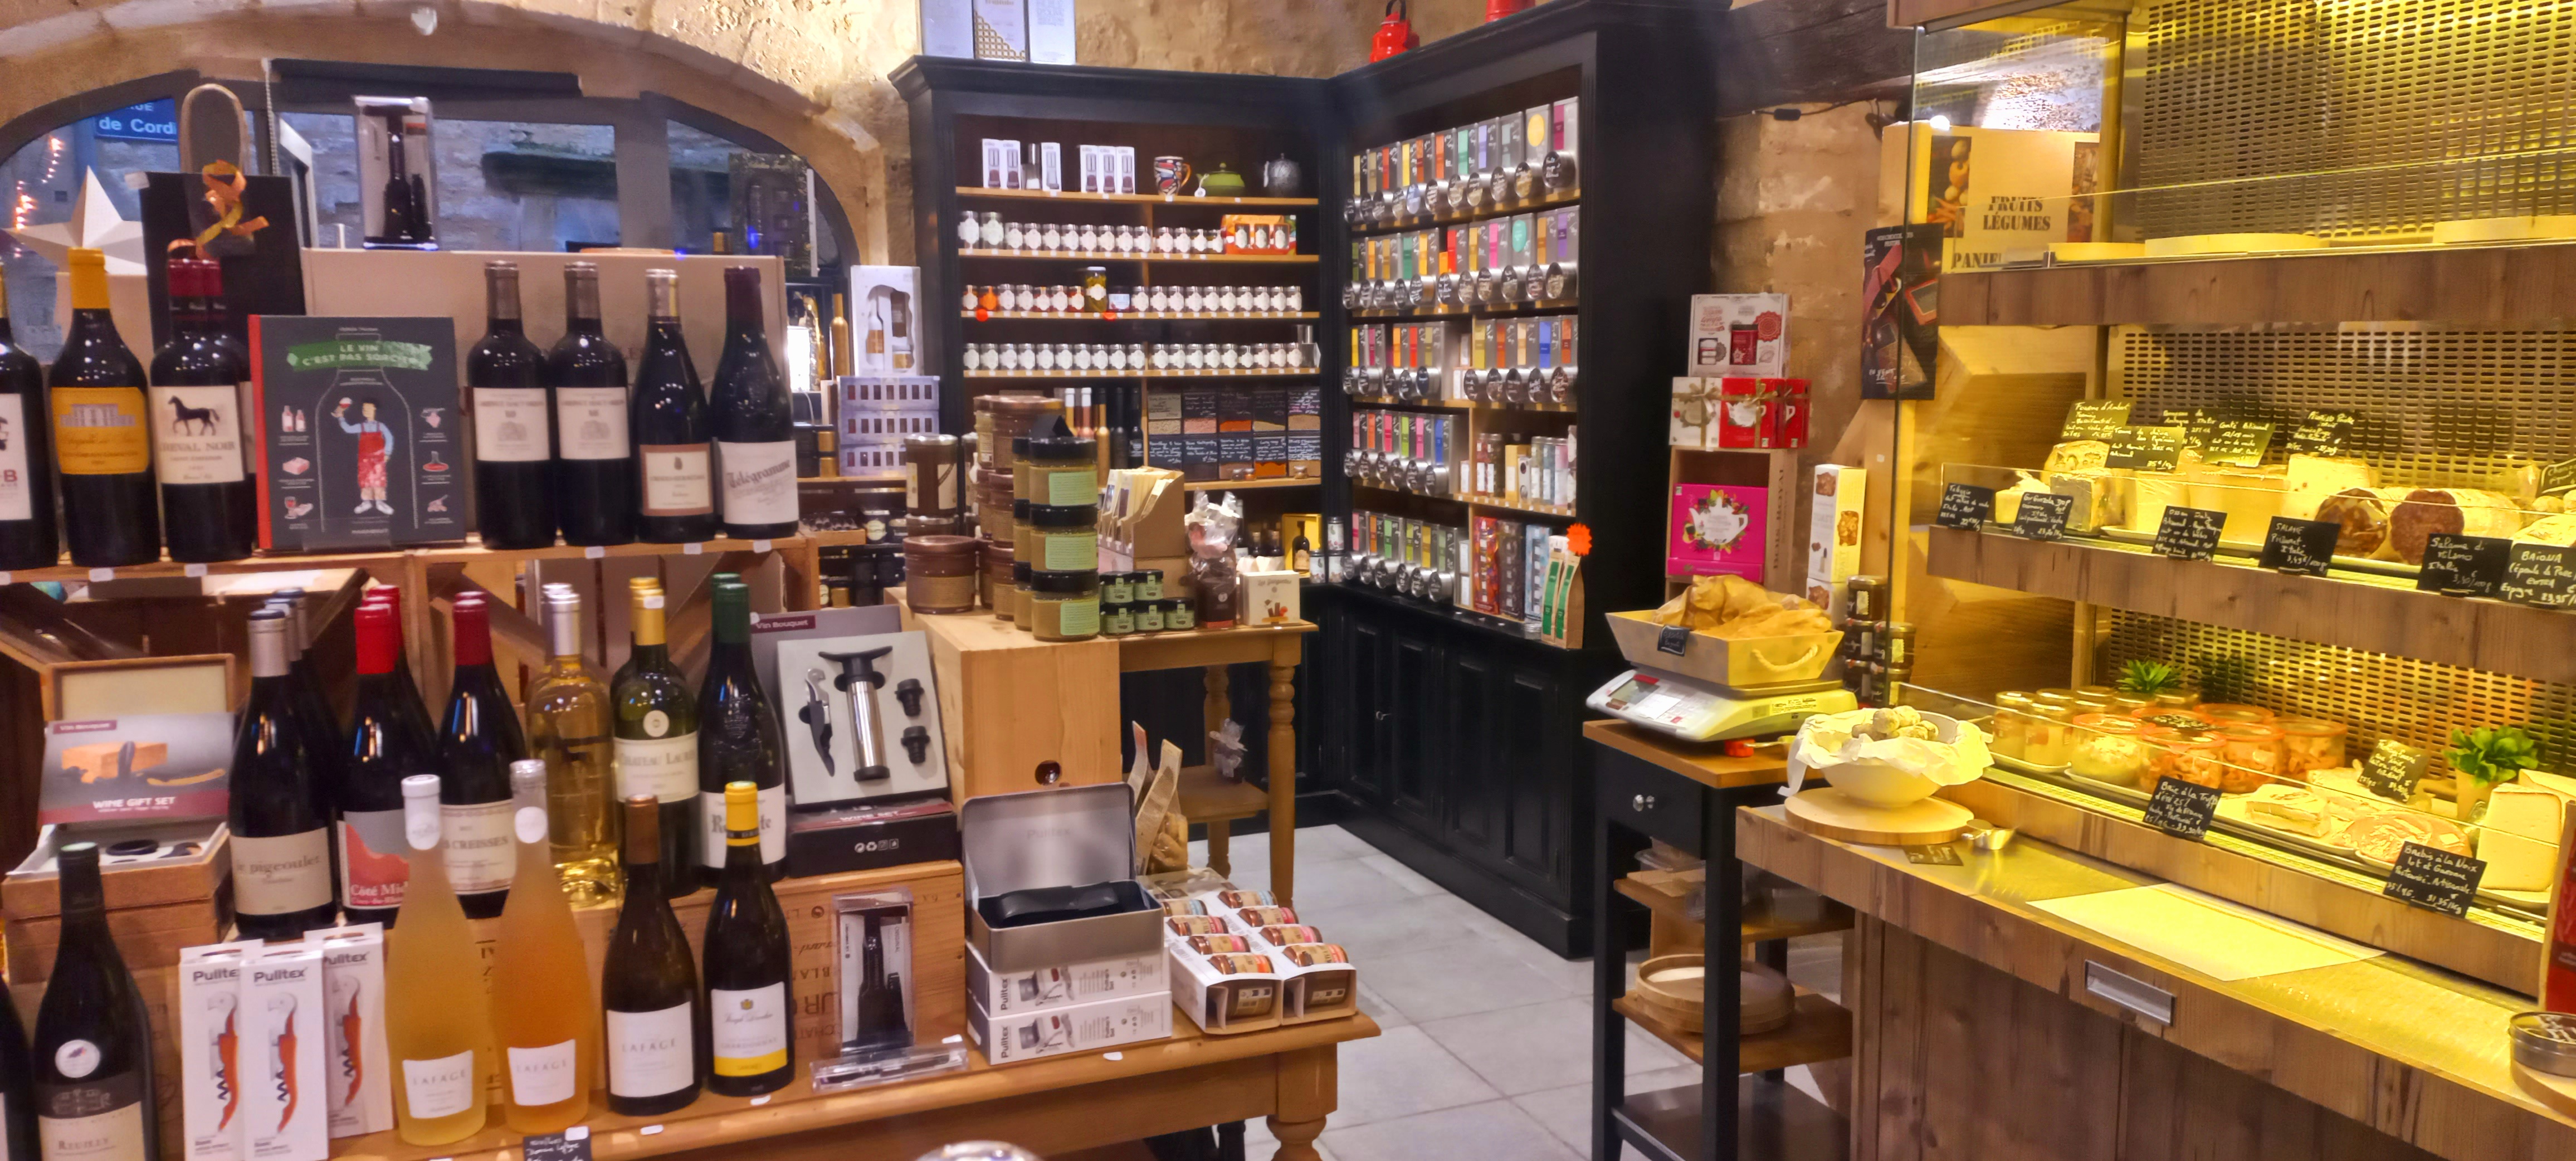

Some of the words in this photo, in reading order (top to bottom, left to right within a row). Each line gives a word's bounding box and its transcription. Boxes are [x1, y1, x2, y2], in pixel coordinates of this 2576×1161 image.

[99, 116, 122, 130] de
[1988, 196, 2043, 212] FRUITS
[1983, 211, 2051, 231] LÉGUMES
[92, 799, 124, 808] WINE
[126, 797, 152, 807] GIFT
[155, 796, 177, 804] SET
[2455, 857, 2478, 873] Noix
[193, 968, 240, 982] Pullte
[253, 968, 305, 983] Pulltex
[1001, 978, 1009, 1011] Pulltex
[621, 1038, 677, 1052] LAFAGE
[1001, 1026, 1009, 1059] Pulltex
[516, 1059, 567, 1073] LAFAGE
[413, 1069, 467, 1086] LAFAGE
